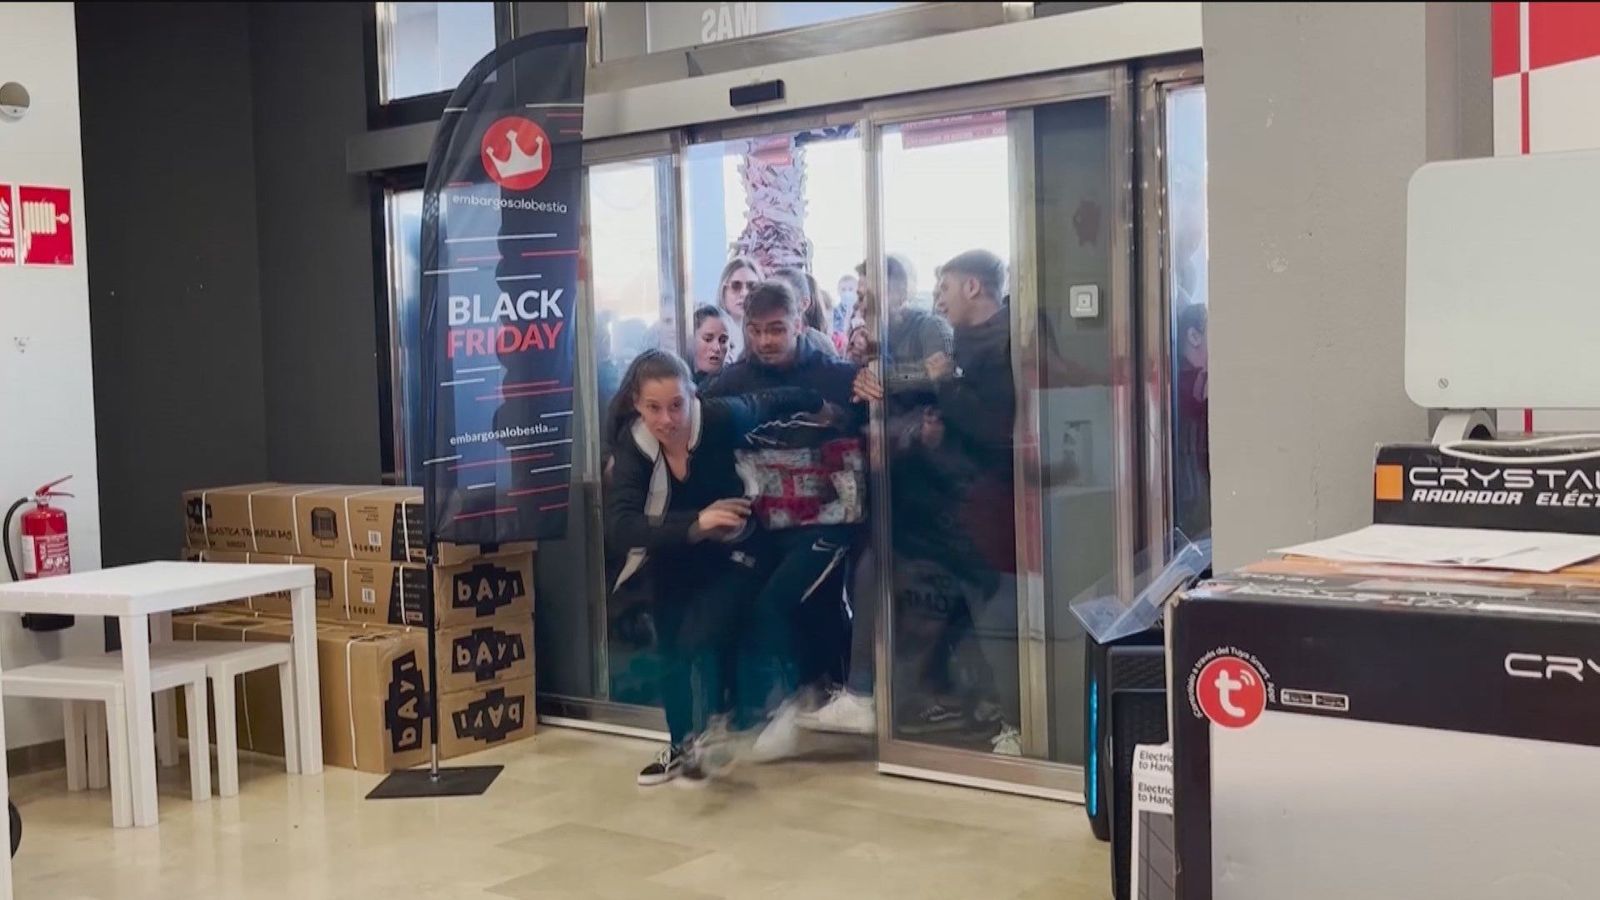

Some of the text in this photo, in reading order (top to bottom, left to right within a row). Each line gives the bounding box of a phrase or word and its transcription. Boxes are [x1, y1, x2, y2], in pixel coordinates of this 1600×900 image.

[448, 288, 564, 326] BLACK
[447, 321, 564, 358] FRIDAY
[1409, 466, 1600, 490] CRYSTA
[1412, 488, 1523, 505] RADIADOR
[1216, 646, 1230, 655] del
[1230, 646, 1250, 660] Tuya
[1139, 761, 1149, 769] to
[1138, 793, 1148, 801] to
